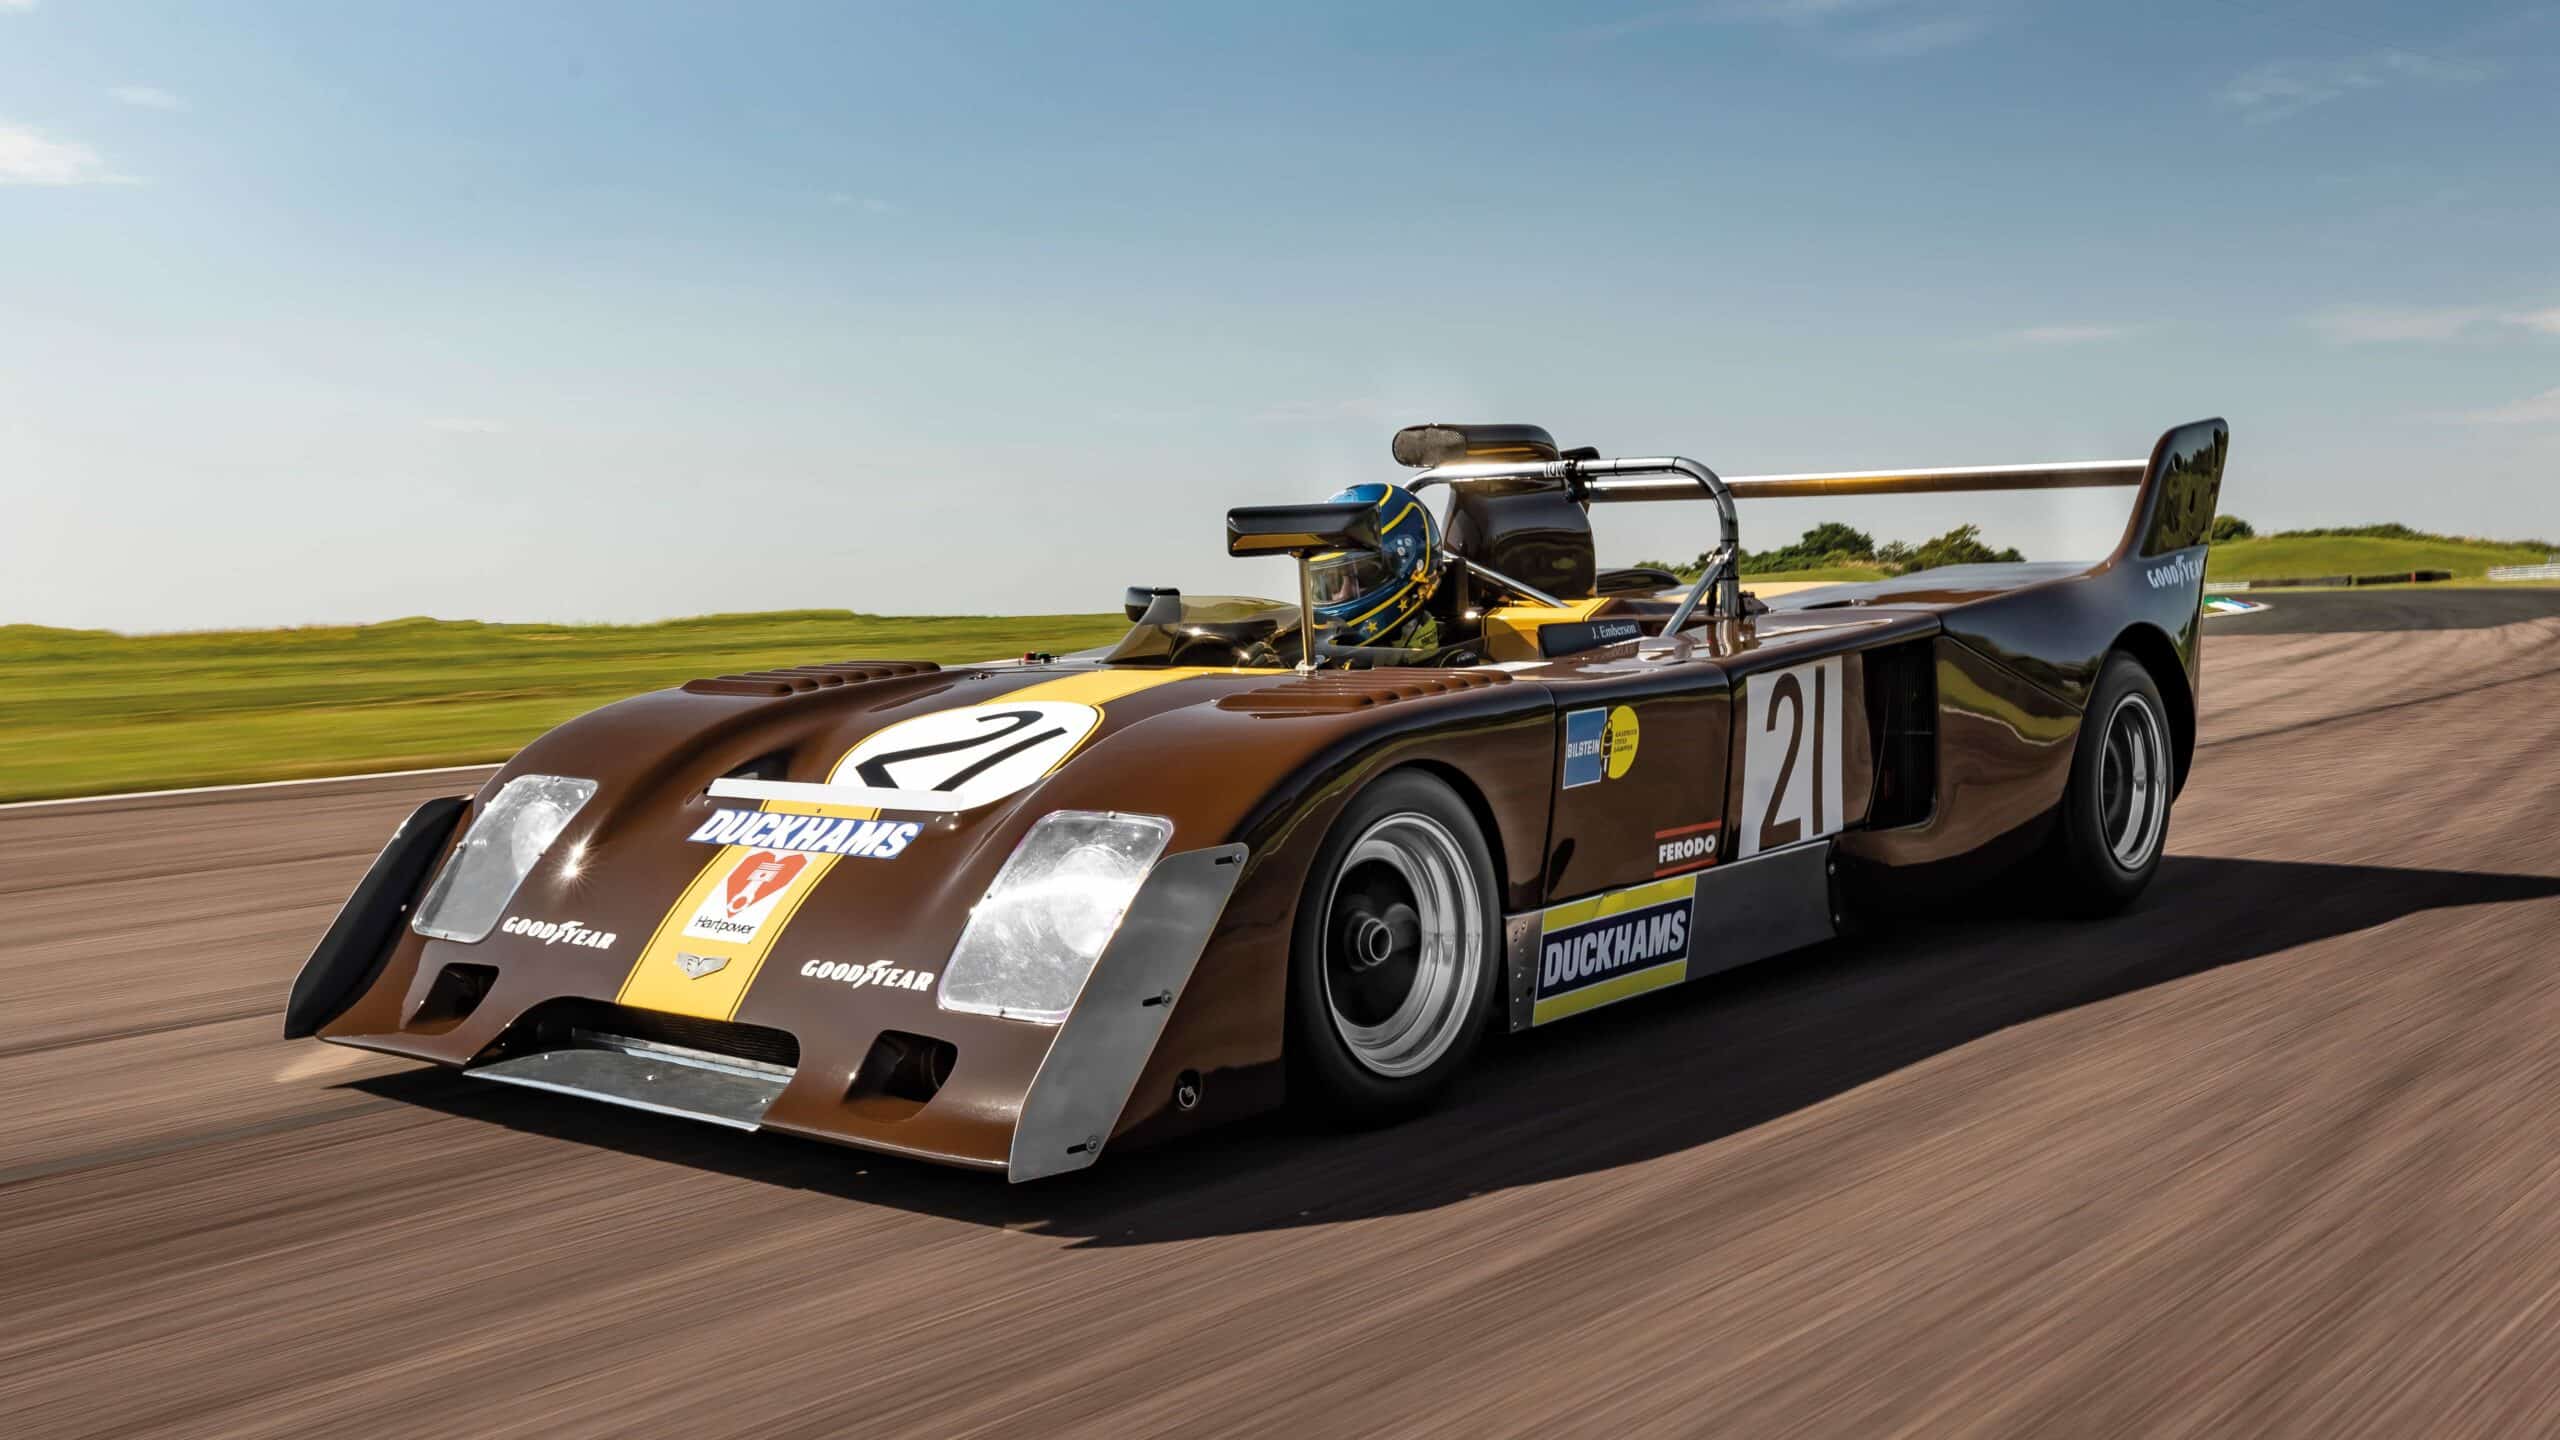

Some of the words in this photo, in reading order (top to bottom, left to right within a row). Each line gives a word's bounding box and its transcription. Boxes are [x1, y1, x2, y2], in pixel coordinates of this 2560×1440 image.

[1599, 624, 1637, 639] Emberson
[855, 710, 1068, 792] 21
[1567, 738, 1600, 759] BILSTEIN
[1759, 665, 1826, 853] 21
[687, 809, 919, 857] DUCKHAMS
[1659, 834, 1716, 864] FERODO
[502, 916, 617, 950] GOODYEAR
[694, 915, 756, 934] Hartpower
[1543, 909, 1687, 988] DUCKHAMS
[800, 959, 936, 992] GOODYEAR
